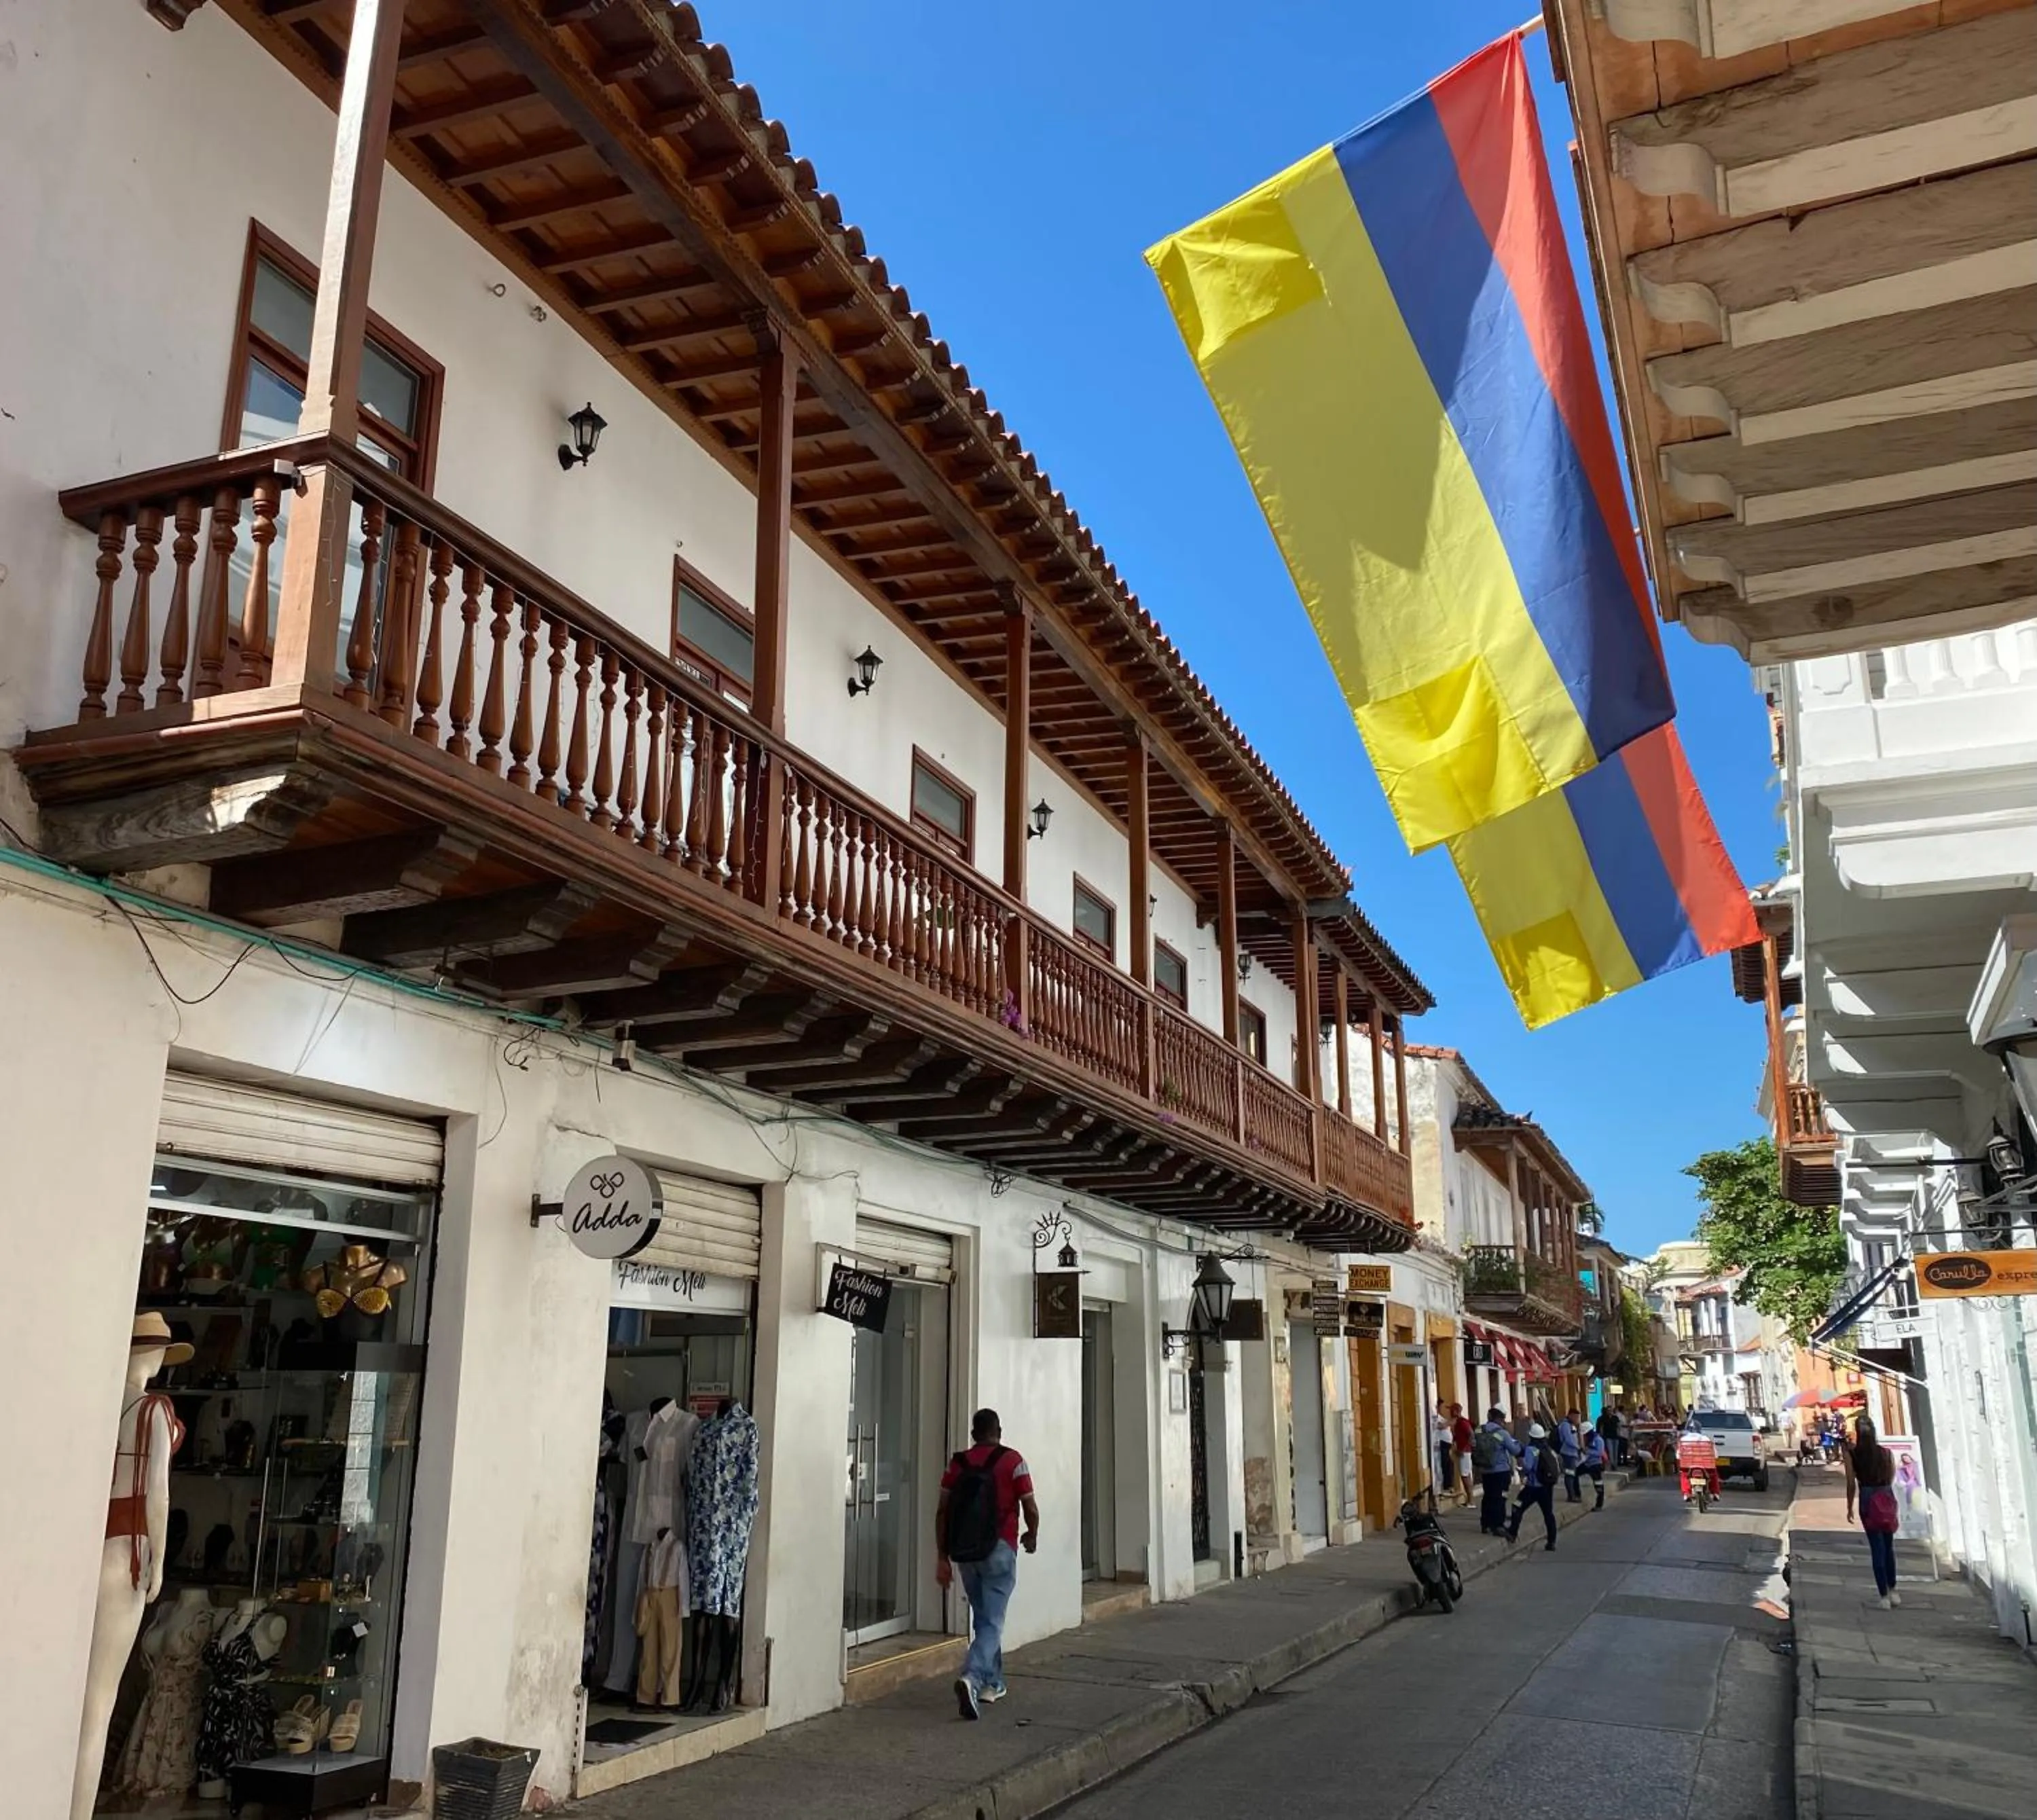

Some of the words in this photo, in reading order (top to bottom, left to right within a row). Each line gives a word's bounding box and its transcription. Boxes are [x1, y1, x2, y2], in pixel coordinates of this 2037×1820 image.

[572, 1200, 642, 1234] Adda
[618, 1260, 671, 1290] Fashion
[1351, 1268, 1389, 1277] MONEY
[834, 1270, 883, 1298] Fashion
[1350, 1279, 1389, 1288] EXCHANGE
[1896, 1323, 1916, 1334] ELA
[1391, 1349, 1424, 1359] WAY
